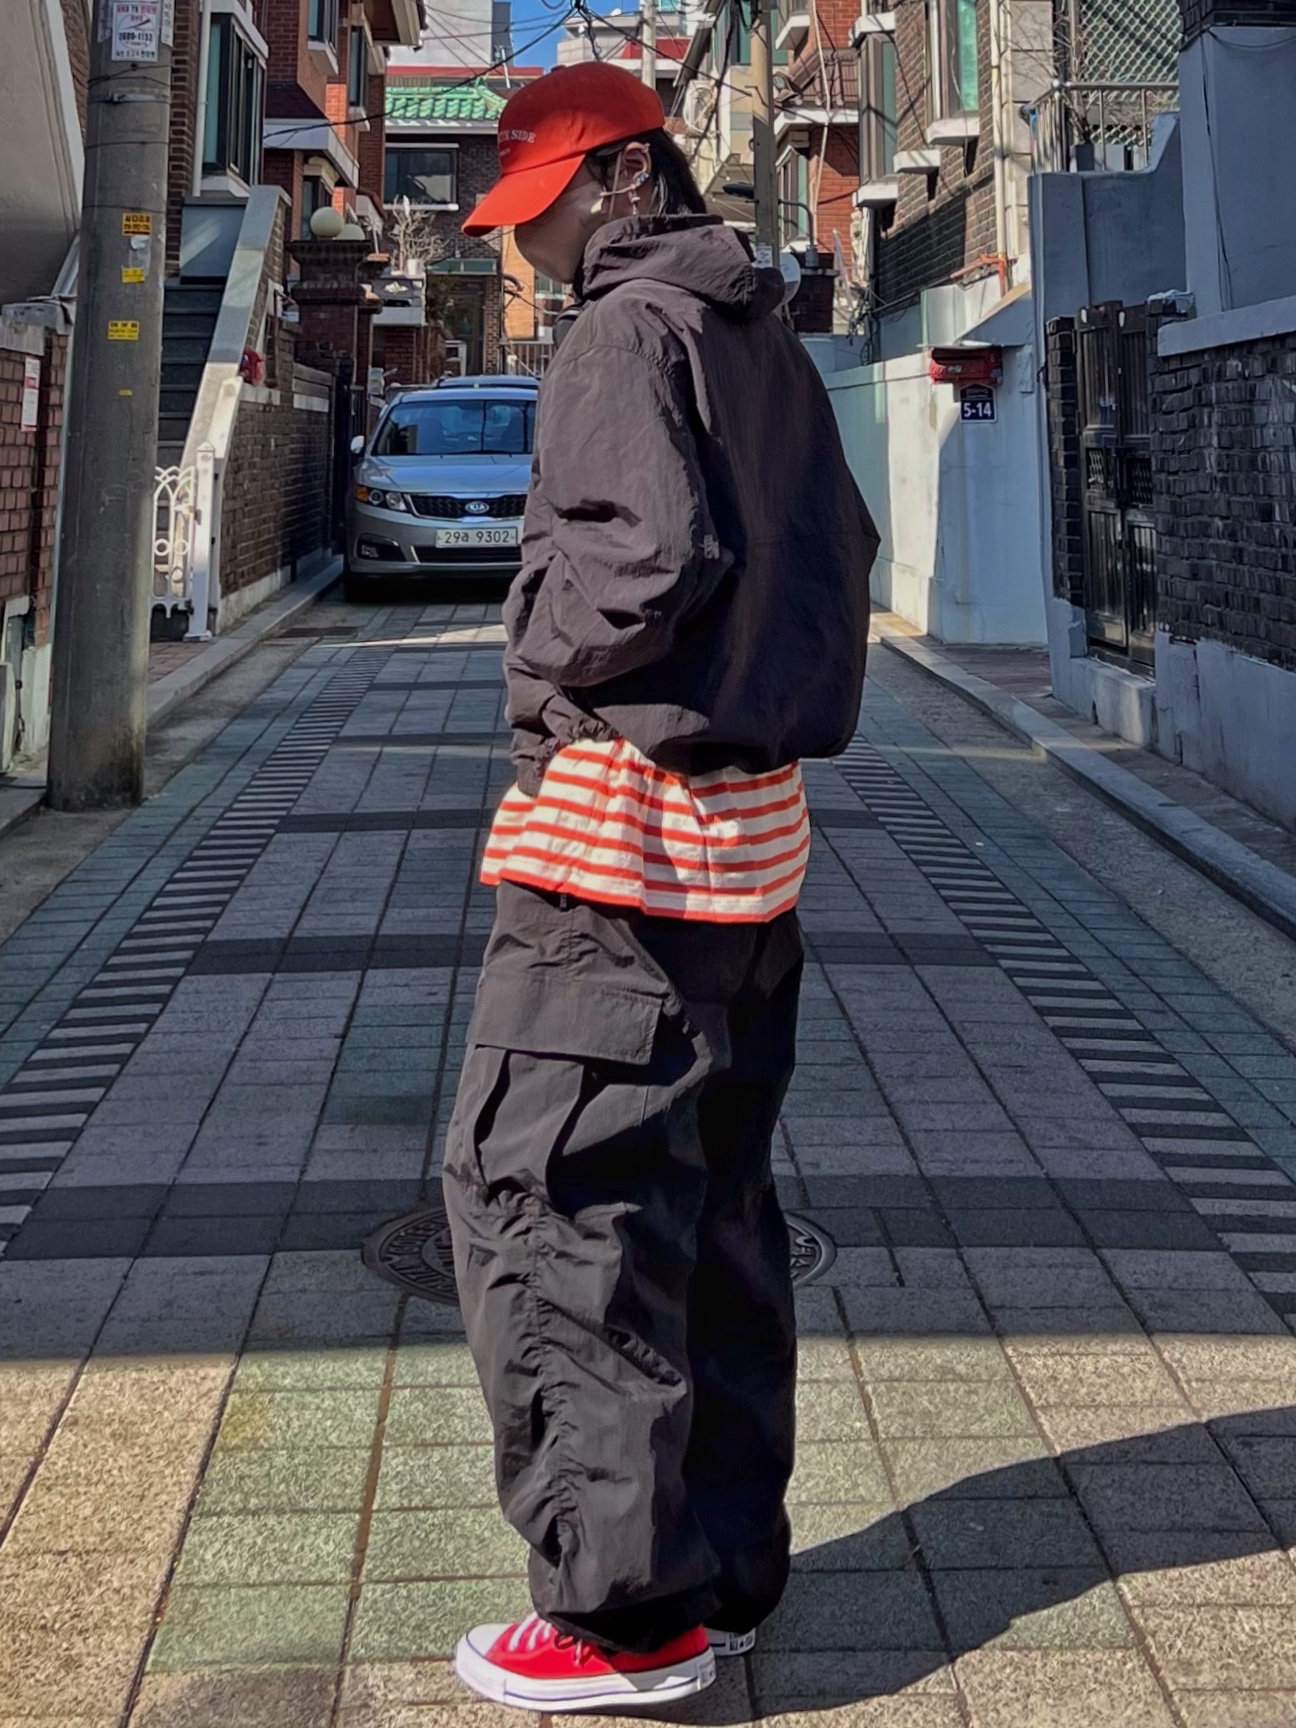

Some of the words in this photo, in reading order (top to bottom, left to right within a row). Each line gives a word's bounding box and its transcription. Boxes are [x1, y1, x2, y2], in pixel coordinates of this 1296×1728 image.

[511, 129, 536, 143] SIDE
[963, 402, 993, 418] 5-14
[476, 530, 509, 543] 9302
